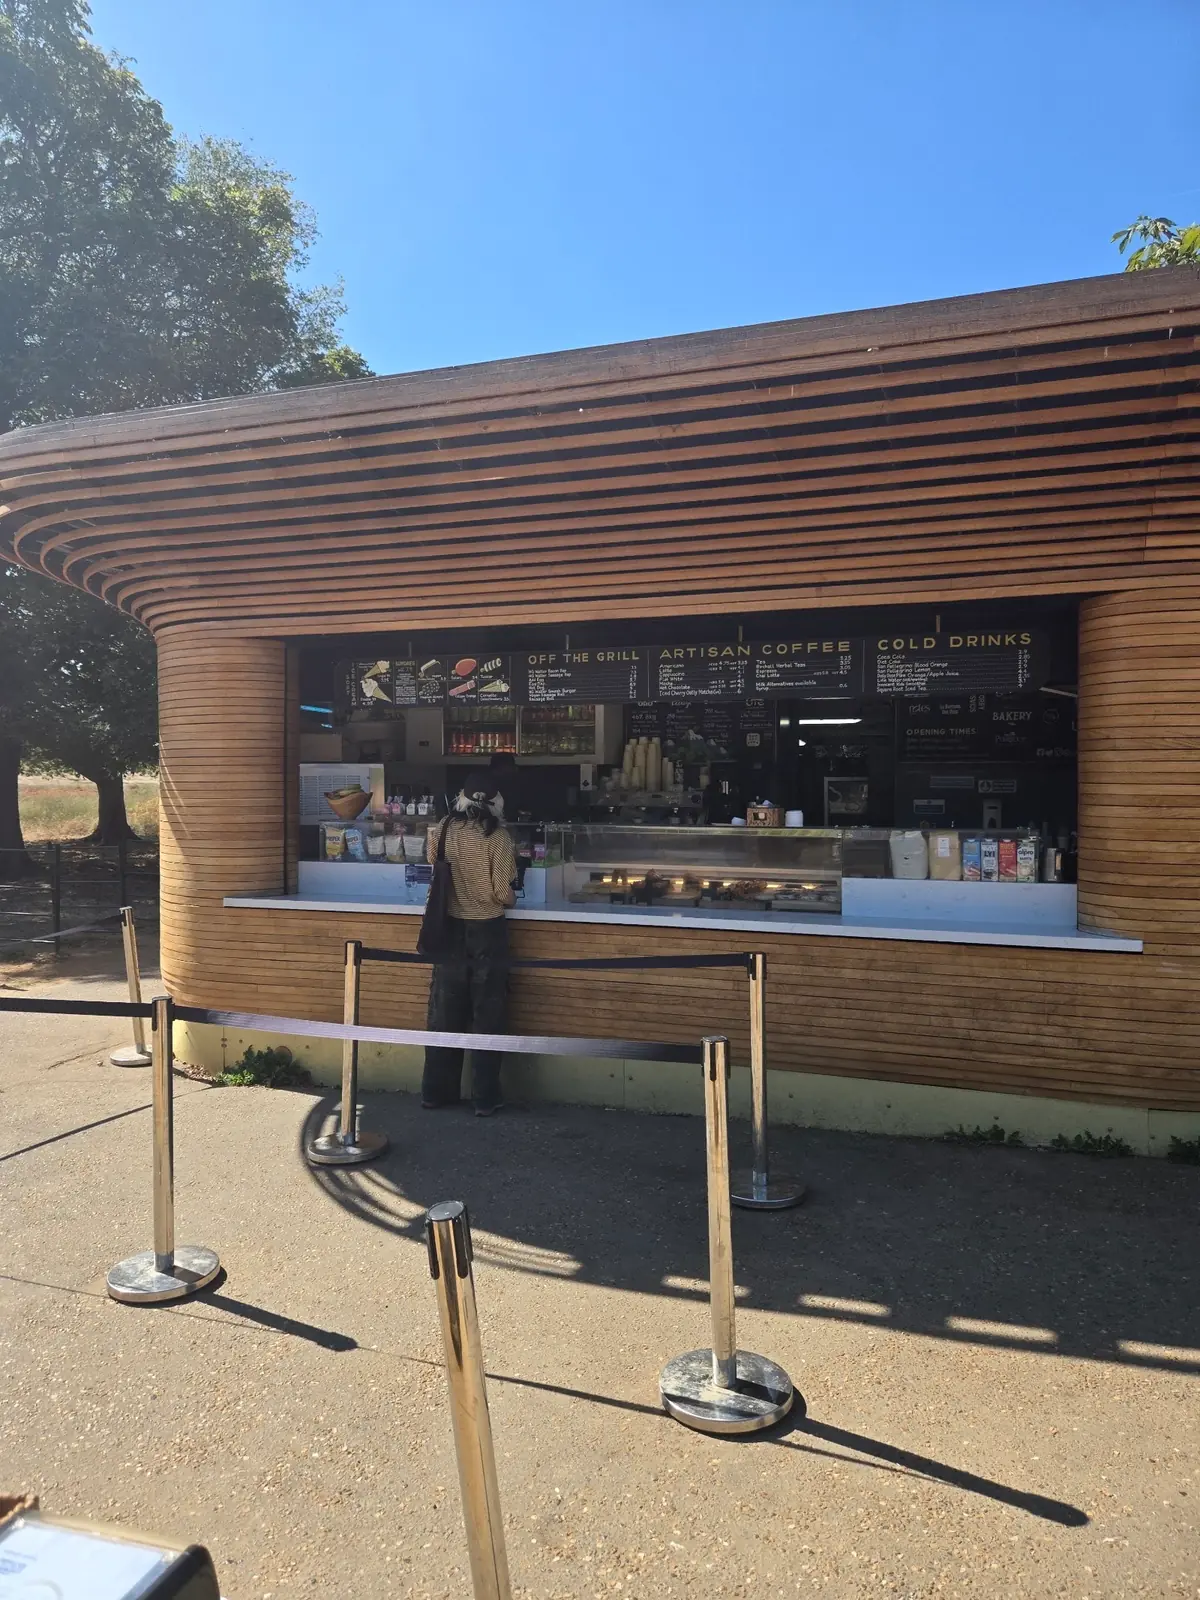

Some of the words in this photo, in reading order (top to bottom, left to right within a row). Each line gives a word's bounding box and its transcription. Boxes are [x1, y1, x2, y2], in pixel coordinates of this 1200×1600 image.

[877, 638, 936, 650] COLD
[950, 632, 1032, 648] DRINKS
[528, 654, 556, 664] OFF
[562, 652, 589, 663] THE
[596, 650, 640, 662] GRILL
[659, 646, 750, 659] ARTISAN
[762, 641, 850, 654] COFFEE
[992, 711, 1032, 721] BAKERY
[1018, 848, 1034, 856] alpro
